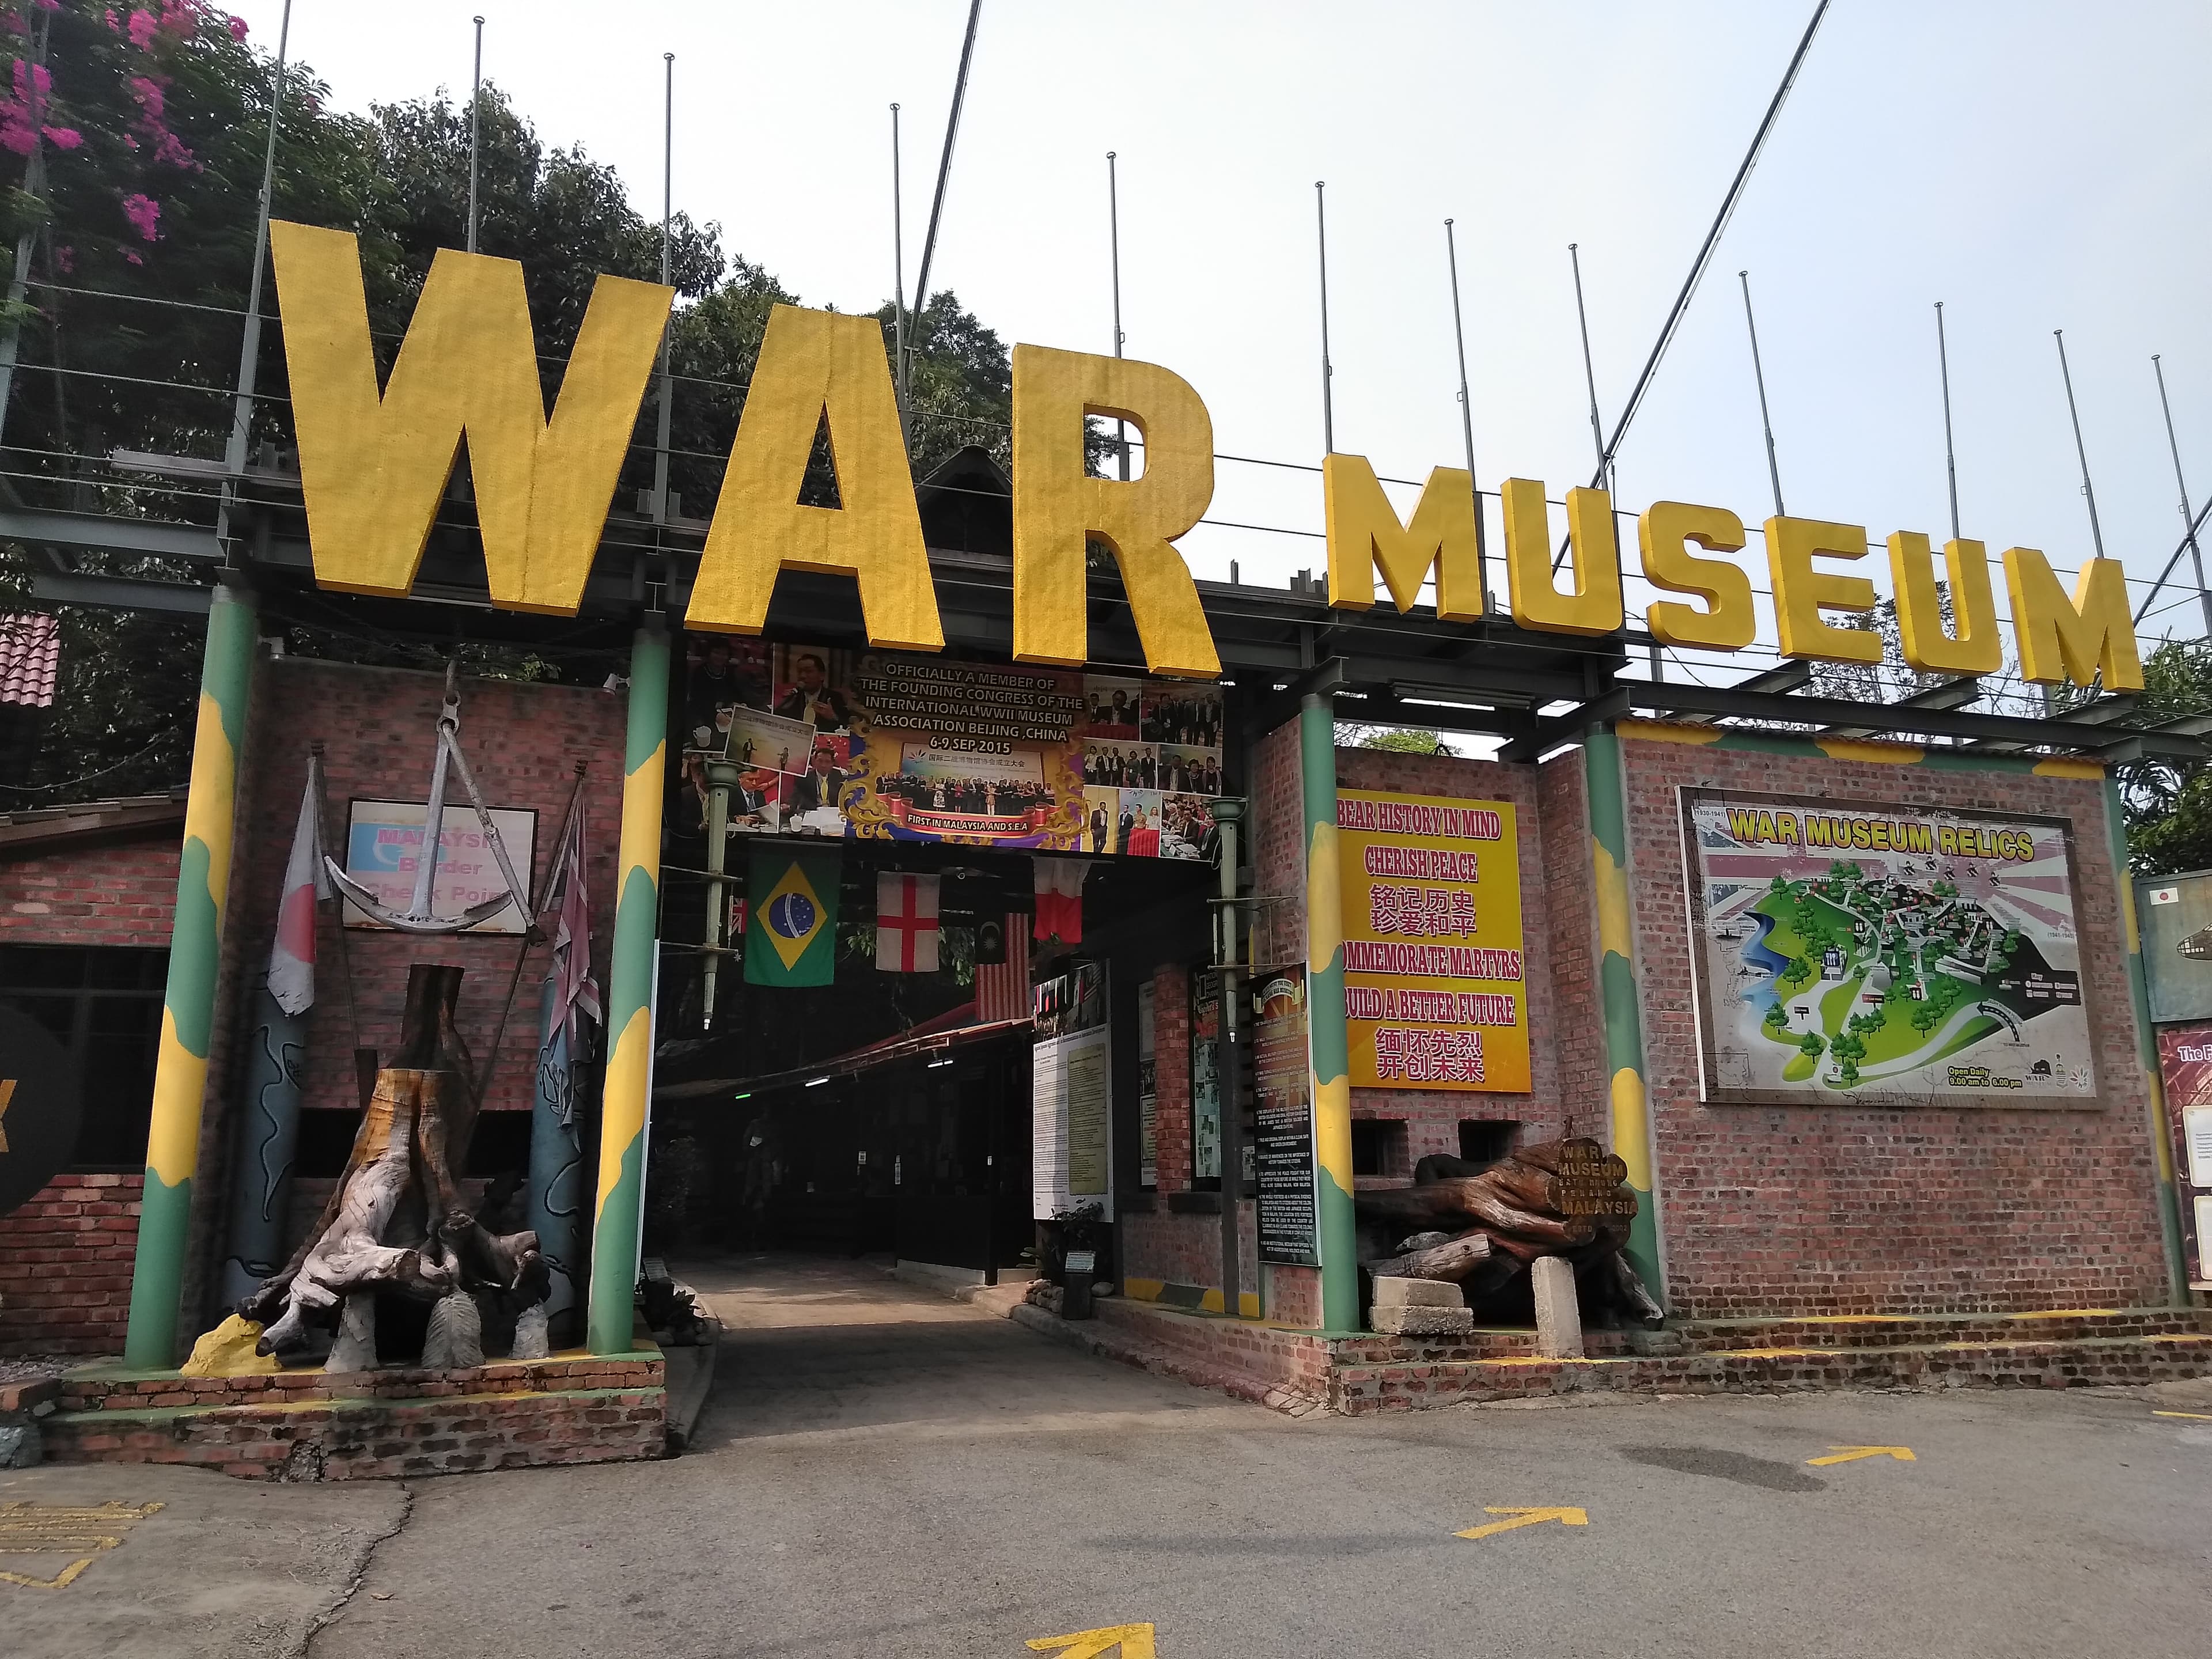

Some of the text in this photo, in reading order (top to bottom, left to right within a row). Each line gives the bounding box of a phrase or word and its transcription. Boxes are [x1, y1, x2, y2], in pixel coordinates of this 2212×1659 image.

[269, 219, 2144, 692] WAR MUSEUM
[886, 664, 1055, 690] OFFICIALLY A MEMBER OF
[860, 678, 1083, 710] THE FOUNDING CONGRESS OF THE
[866, 696, 1073, 725] INTERNATIONAL WWII MUSEUM
[873, 714, 965, 732] ASSOCIATION
[968, 723, 1019, 737] BEIJING
[930, 737, 1010, 753] 6-9 SEP 2015
[908, 814, 1028, 831] FIRST IN MALAYSIA AND S.E.A
[1336, 799, 1501, 839] BEAR HISTORY IN MIND
[1694, 809, 1725, 818] (1930-1941)
[1726, 808, 2035, 861] WAR MUSEUM RELICS
[399, 857, 483, 875] Brder
[1364, 845, 1478, 882] CHERISH PEACE
[1369, 883, 1475, 914] 铭记历史
[1370, 908, 1476, 937] 珍爱和平
[1449, 946, 1521, 979] MARTYRS
[1384, 988, 1397, 1019] A
[1399, 988, 1456, 1022] BETTER
[1457, 992, 1516, 1024] FUTURE
[1375, 1027, 1482, 1056] 缅怀先烈
[2177, 1046, 2203, 1062] The
[1376, 1054, 1484, 1081] 开创未来
[1948, 1066, 1990, 1077] Open Daily
[1949, 1077, 1966, 1086] 9.00
[1980, 1078, 1990, 1086] to
[1991, 1078, 2009, 1086] 6.00
[2009, 1080, 2022, 1089] pm
[1563, 1146, 1599, 1158] WAR
[1558, 1162, 1623, 1176] MUSEUM
